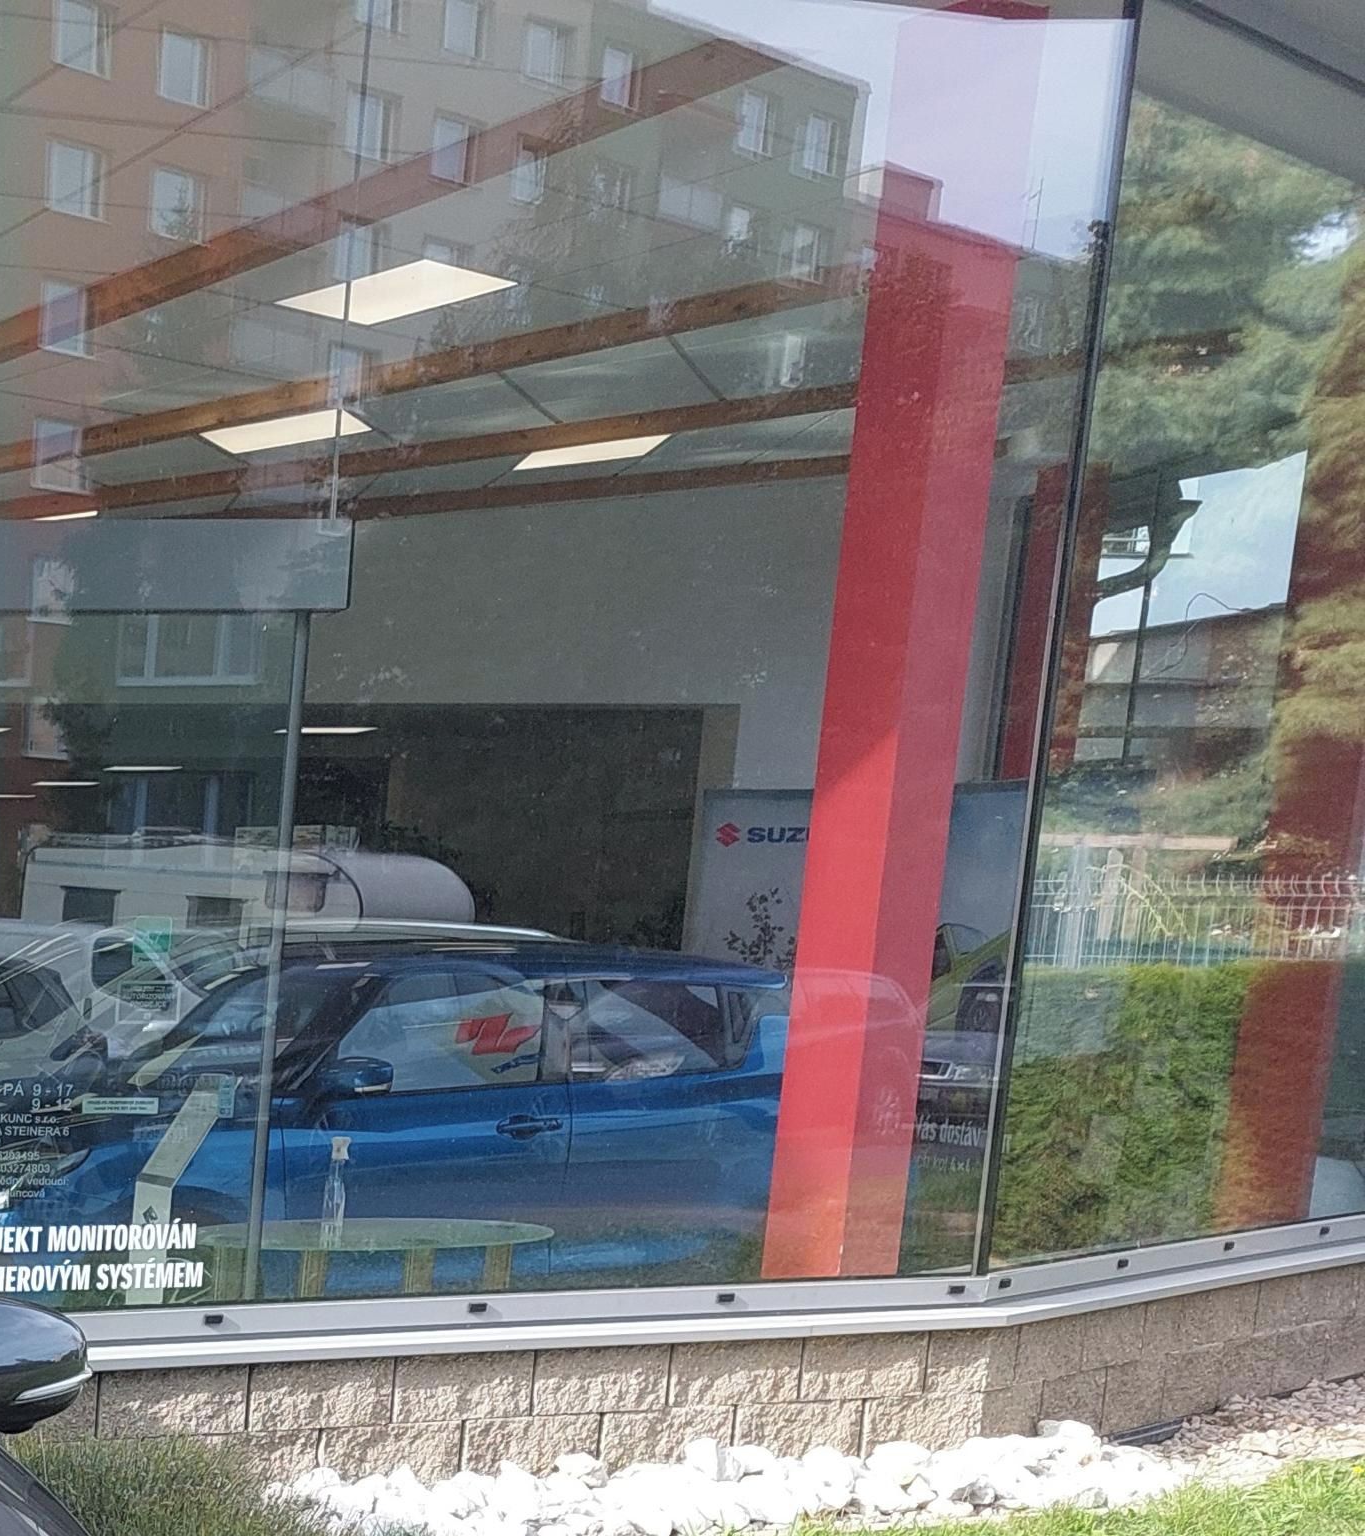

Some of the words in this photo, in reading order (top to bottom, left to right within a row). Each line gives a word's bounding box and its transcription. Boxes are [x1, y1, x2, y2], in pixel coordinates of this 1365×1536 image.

[746, 826, 810, 843] SUZ
[2, 1080, 25, 1097] PÁ
[32, 1083, 42, 1097] 9
[56, 1083, 74, 1097] 17
[31, 1097, 41, 1112] 9
[0, 1113, 33, 1123] KUNC
[4, 1125, 62, 1137] STEINERA
[46, 1217, 198, 1252] MONITOROVÁN
[95, 1257, 205, 1291] SYSTÉMEM
